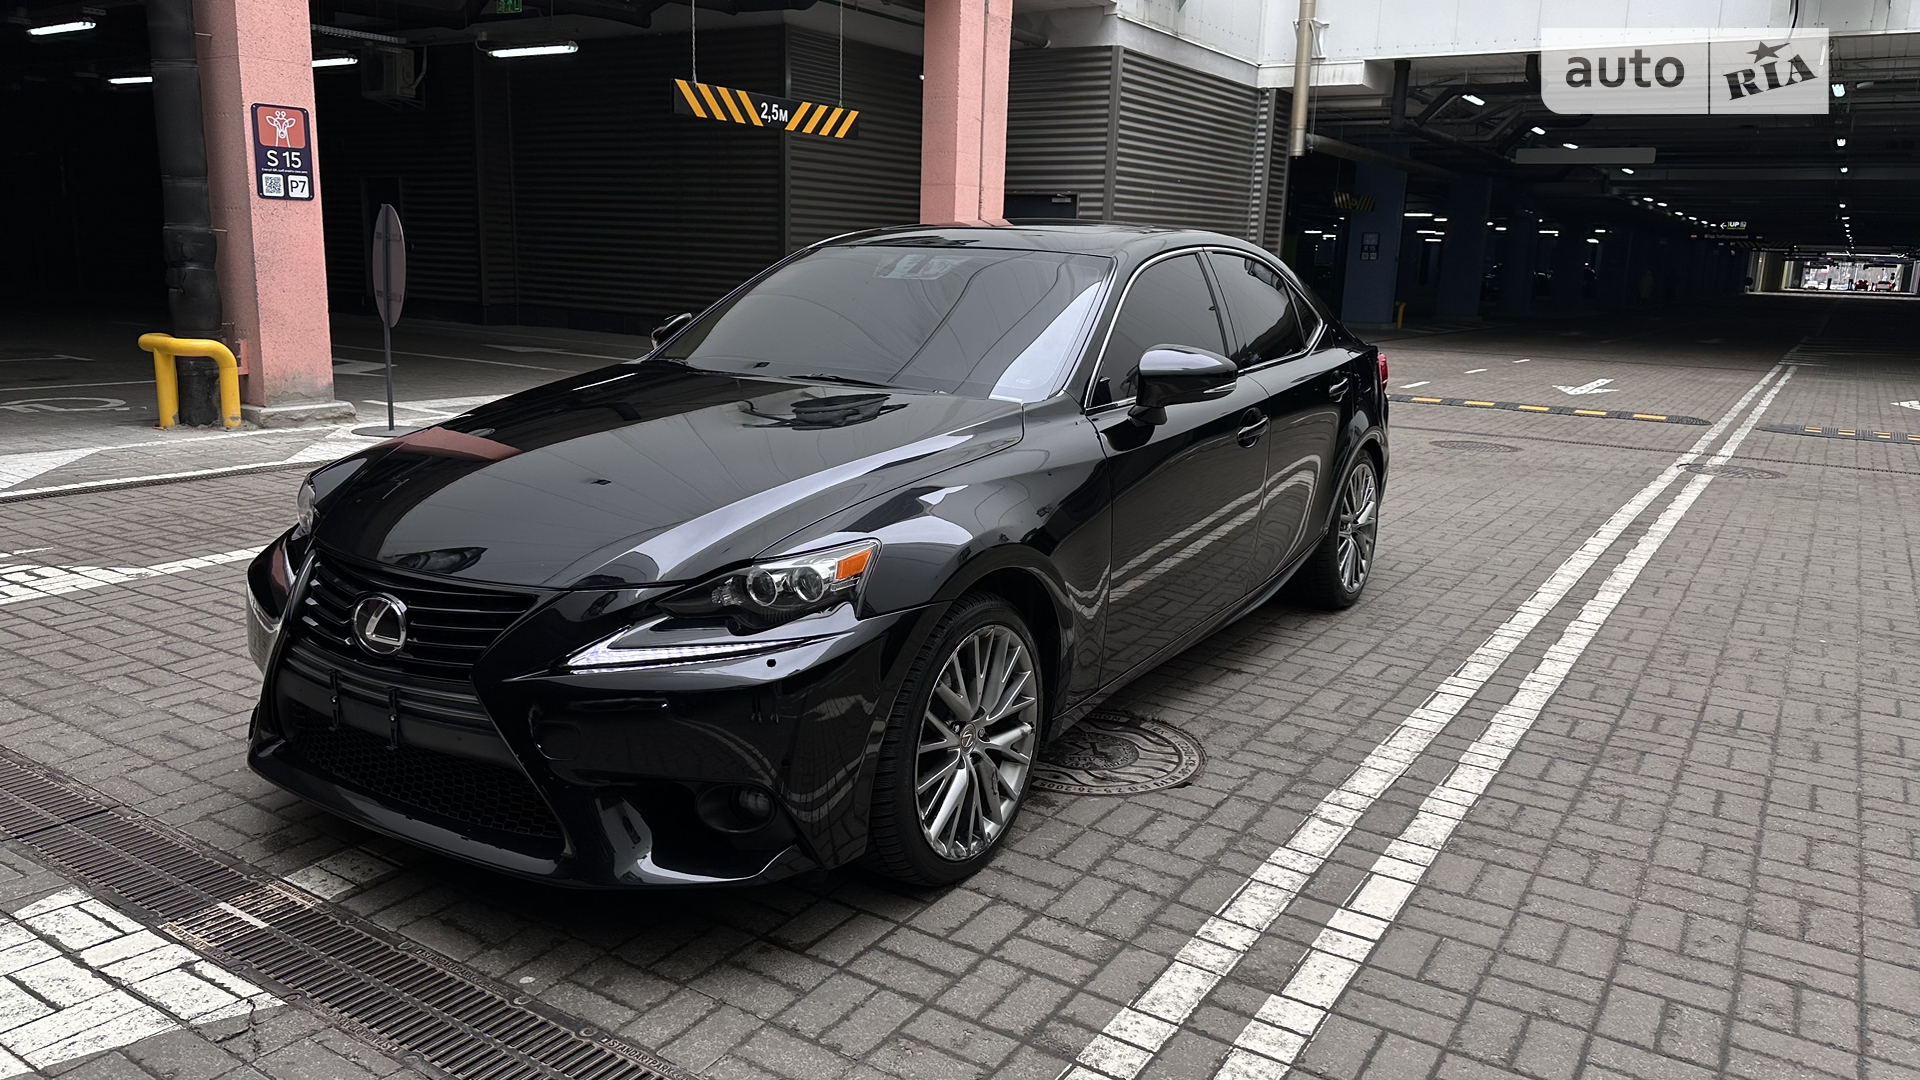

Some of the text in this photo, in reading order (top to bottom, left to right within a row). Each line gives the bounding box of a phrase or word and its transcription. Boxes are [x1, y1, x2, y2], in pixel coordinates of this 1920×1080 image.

[266, 150, 302, 169] S 15
[290, 180, 306, 193] P7
[608, 1040, 675, 1076] STANDARTPARK
